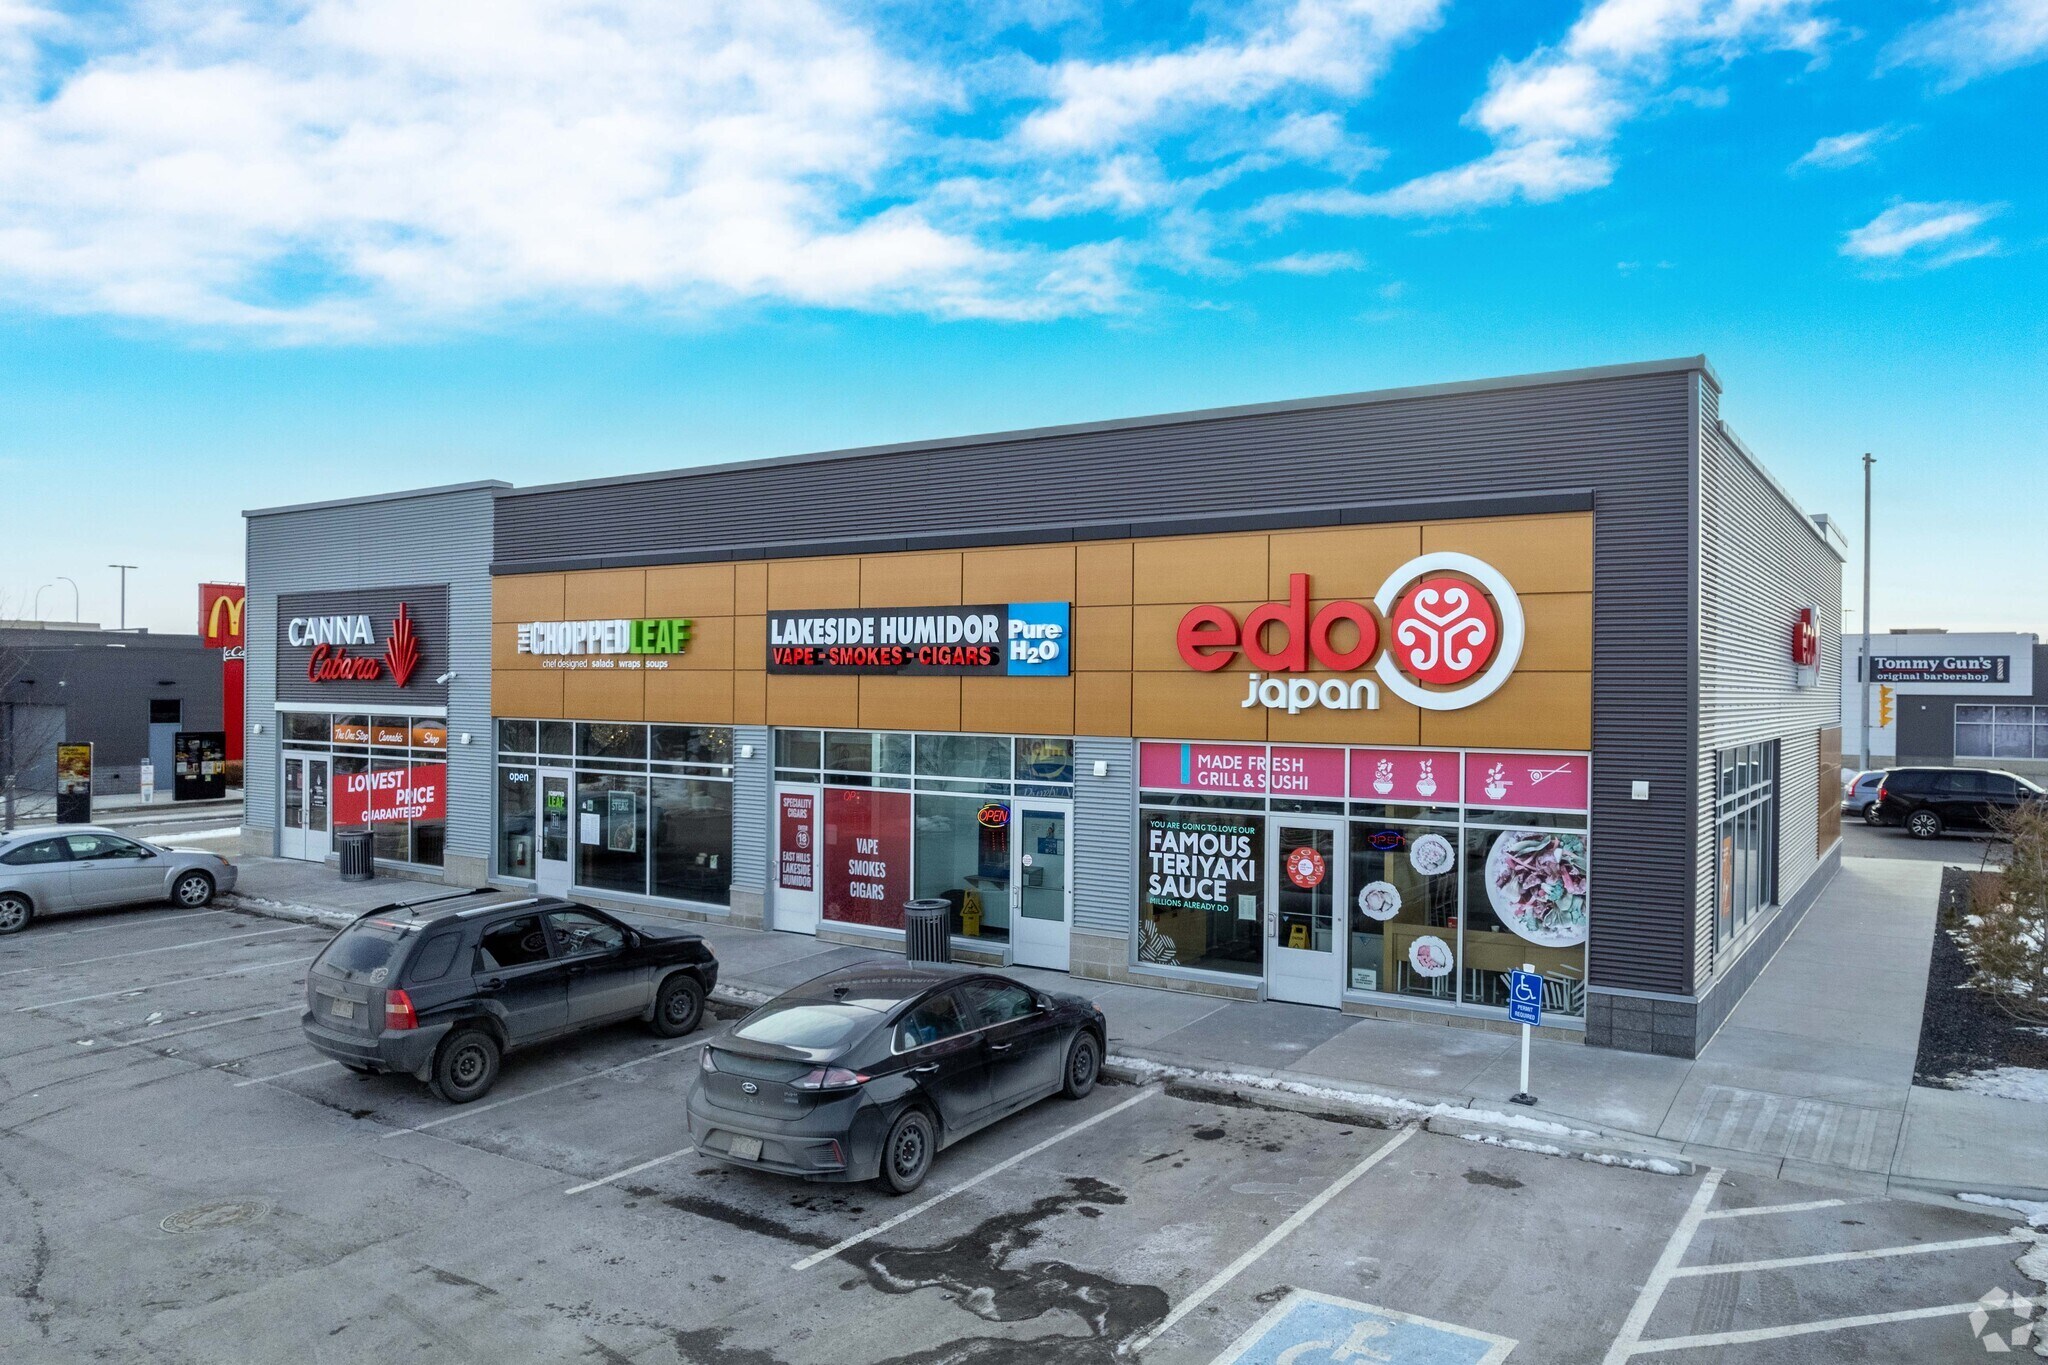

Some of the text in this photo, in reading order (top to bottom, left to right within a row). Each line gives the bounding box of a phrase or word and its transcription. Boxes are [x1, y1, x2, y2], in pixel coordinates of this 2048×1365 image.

[288, 615, 375, 646] CANNA
[771, 614, 1000, 645] LAKESIDE HUMIDOR
[1008, 619, 1062, 640] Pure
[1177, 573, 1380, 672] edo
[530, 619, 692, 655] CHOPPED LEAF
[773, 647, 815, 665] VAPE
[829, 646, 902, 666] SMOKES
[919, 646, 992, 666] CIGARS
[1010, 640, 1060, 664] H2O
[308, 643, 382, 683] Cabana
[542, 659, 668, 670] chef designed salads wraps soups
[1875, 657, 1992, 671] Tommy Gun's
[1877, 672, 1989, 682] original barbershop
[1241, 673, 1380, 715] japan
[356, 729, 369, 742] Stop
[378, 730, 403, 743] Cannabis
[423, 732, 440, 745] Shop
[1198, 755, 1303, 772] MADE FRESH
[348, 770, 404, 792] LOWEST
[509, 772, 529, 783] open
[1198, 771, 1308, 790] GRILL & SUSHI
[396, 786, 435, 805] PRICE
[787, 808, 807, 819] CIGARS
[980, 810, 1008, 822] OPEN
[856, 838, 878, 855] VAPE
[1150, 829, 1251, 858] FAMOUS
[782, 851, 811, 863] EAST HILLS
[782, 862, 811, 875] LAKESIDE
[849, 859, 886, 878] SMOKES
[1149, 852, 1255, 882] TERIYAKI
[782, 874, 812, 887] HUMIDOR
[1149, 874, 1227, 902] SAUCE
[850, 881, 884, 900] CIGARS
[1149, 898, 1181, 907] MILLIONS
[1183, 901, 1216, 911] ALREADY
[1514, 1011, 1535, 1020] REQUIRED
[1517, 1004, 1533, 1012] PERMIT
